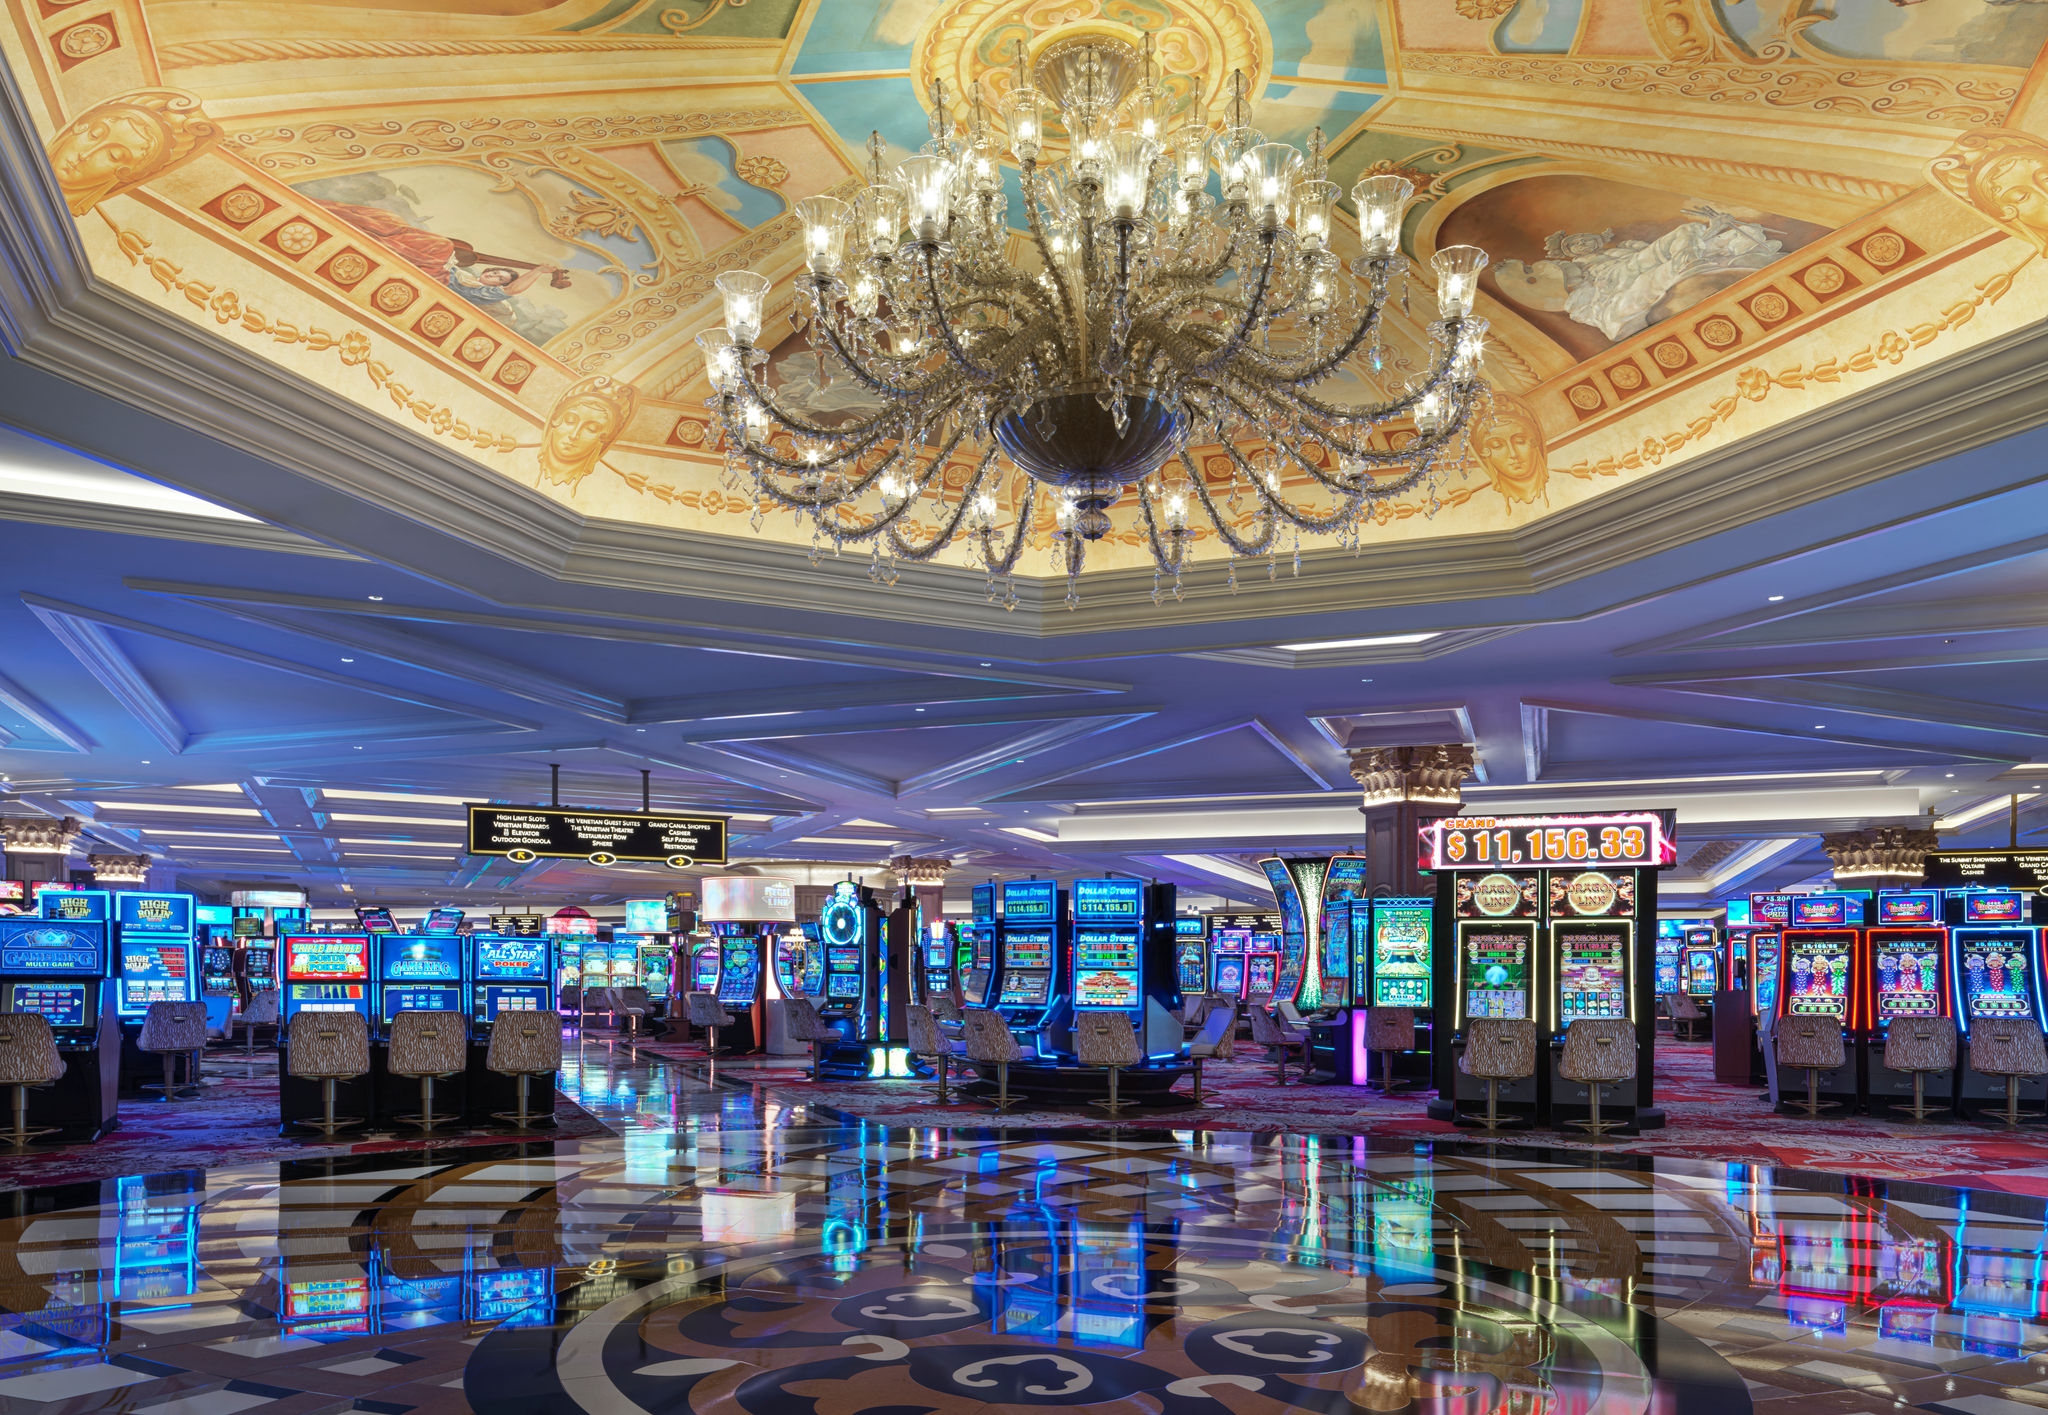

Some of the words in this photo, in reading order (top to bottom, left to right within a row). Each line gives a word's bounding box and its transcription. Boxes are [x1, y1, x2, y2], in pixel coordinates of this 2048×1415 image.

[1445, 817, 1496, 829] GRAND
[1029, 888, 1050, 896] STORM
[1110, 886, 1137, 895] STORM
[1472, 883, 1522, 894] DRAGON
[1567, 882, 1617, 893] DRAGON
[59, 898, 88, 908] HIGH
[138, 900, 170, 909] HIGH
[1482, 897, 1512, 906] LINK
[1578, 896, 1608, 906] LINK
[137, 909, 174, 919] ROLLIN'
[292, 944, 325, 953] TRIPLE
[326, 944, 363, 953] DOUBLE
[487, 947, 537, 960] ALL-STAR
[309, 954, 346, 962] BONUS
[308, 963, 347, 972] POKER
[391, 961, 423, 976] GAME
[424, 961, 452, 976] KING
